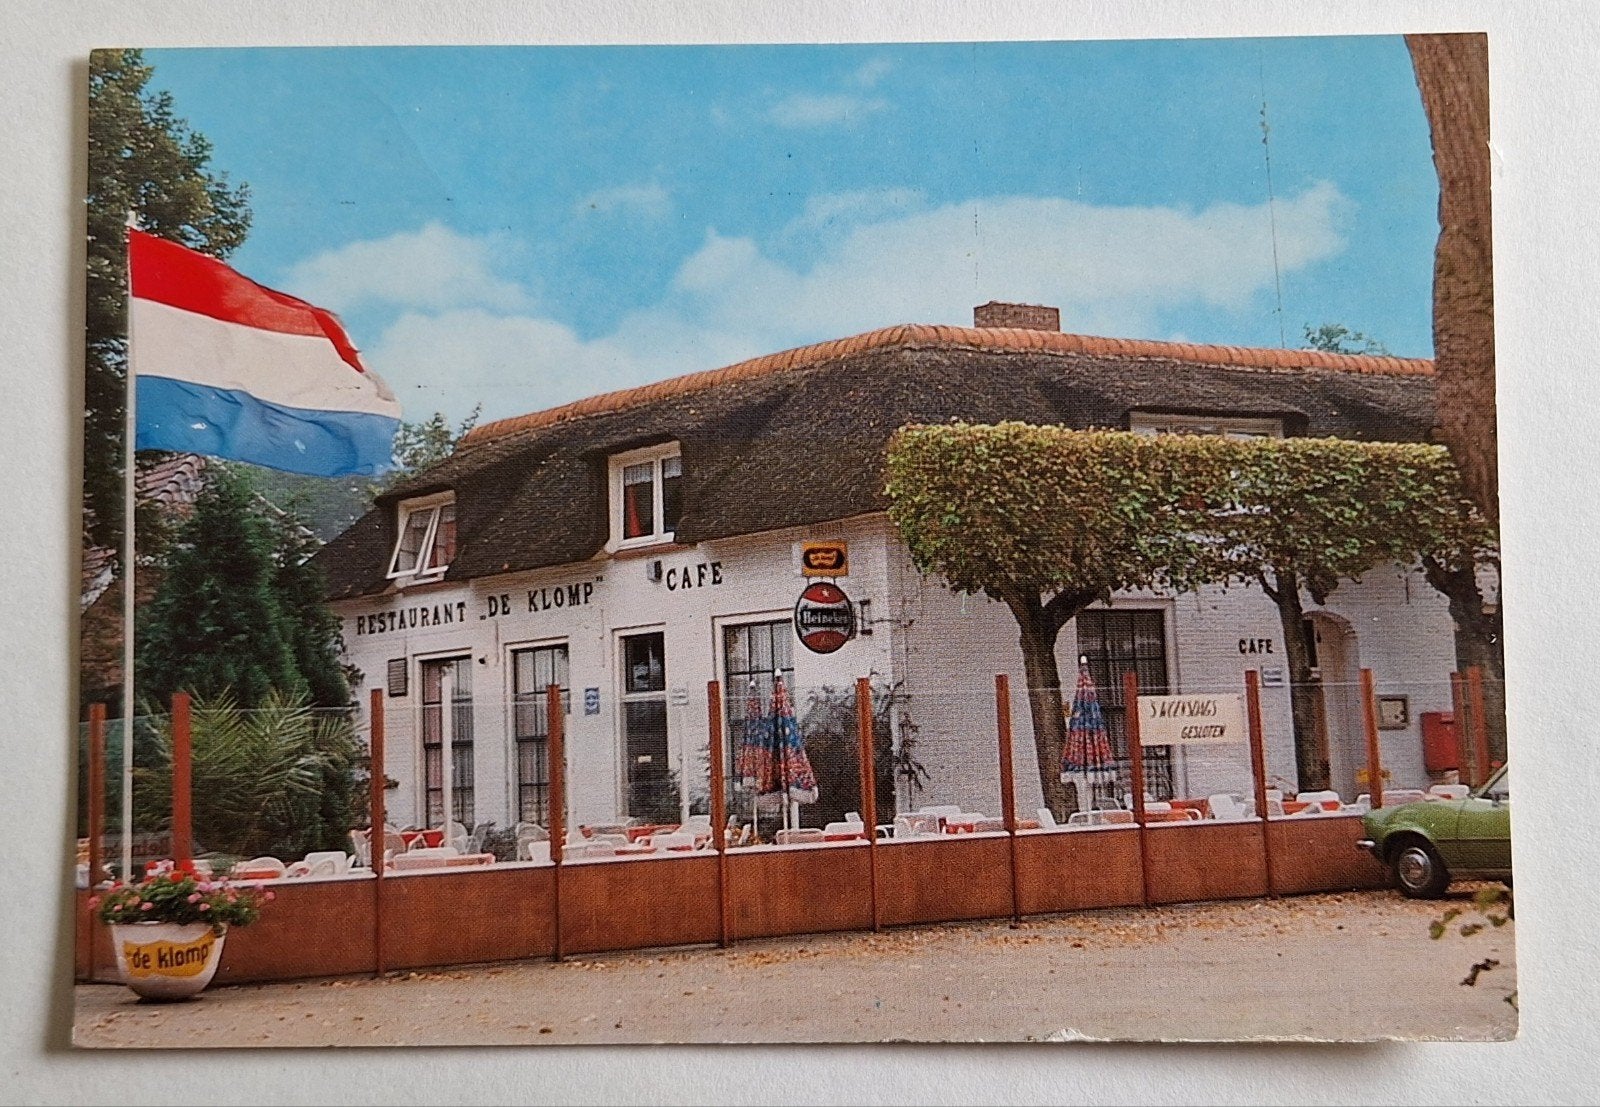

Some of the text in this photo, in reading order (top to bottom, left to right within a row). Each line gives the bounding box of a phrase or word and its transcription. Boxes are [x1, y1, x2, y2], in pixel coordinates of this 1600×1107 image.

[666, 561, 723, 591] CAFE
[357, 602, 466, 635] RESTAURANT
[1238, 638, 1274, 654] CAFE
[1180, 724, 1227, 740] GESLOTEN
